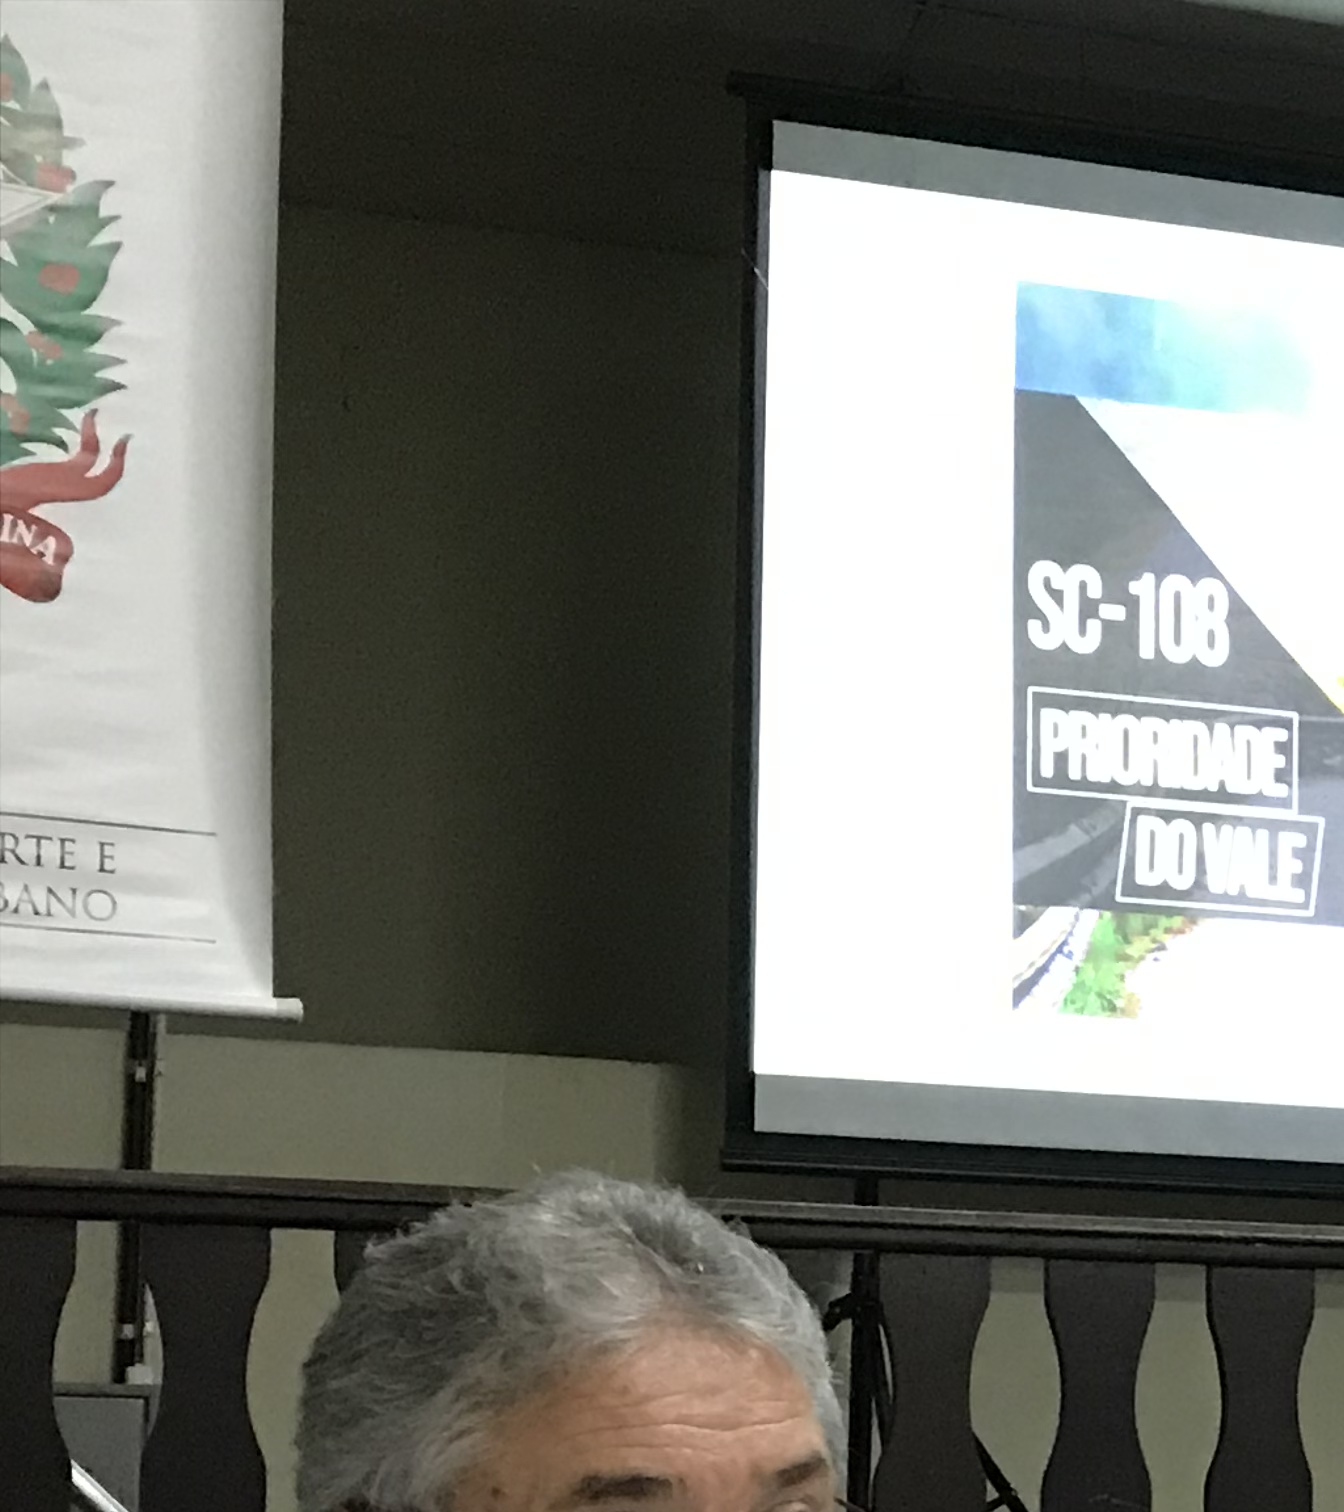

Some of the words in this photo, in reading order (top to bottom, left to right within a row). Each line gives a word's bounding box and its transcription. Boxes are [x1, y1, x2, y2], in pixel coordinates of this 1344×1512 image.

[1027, 559, 1230, 667] SC-108
[1039, 707, 1289, 799] PRIORIDADE
[97, 841, 117, 874] E
[1135, 814, 1198, 891] DO
[1202, 822, 1308, 904] VALE
